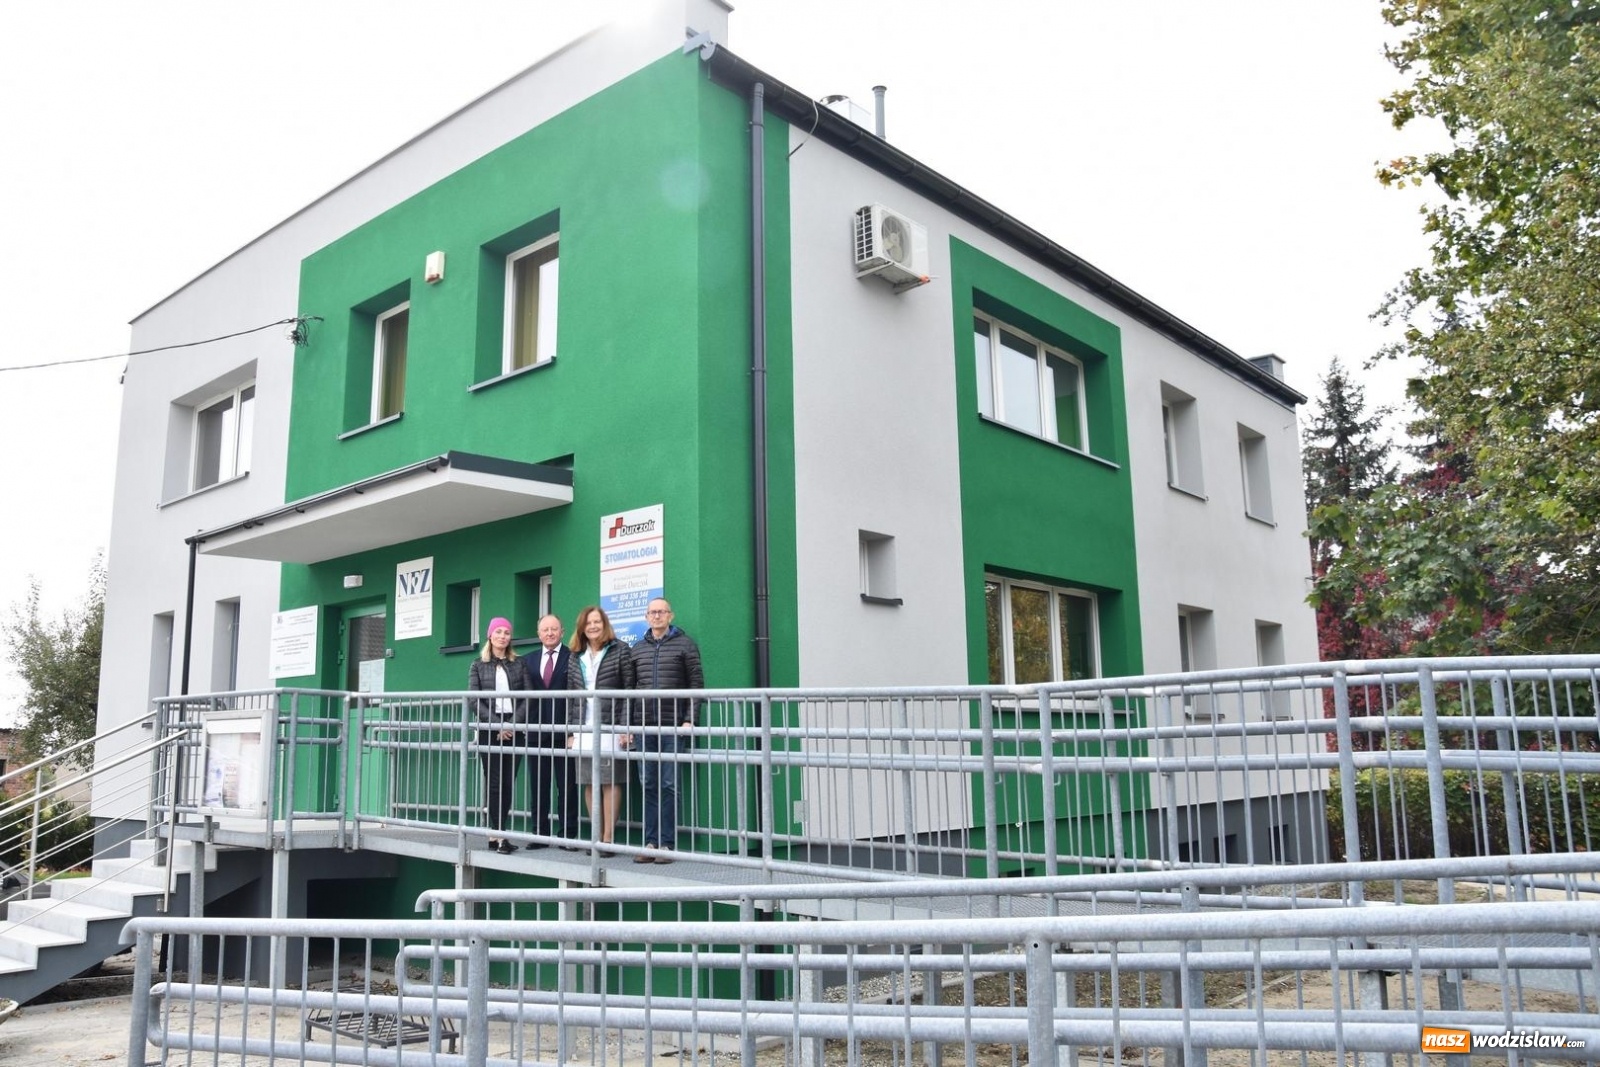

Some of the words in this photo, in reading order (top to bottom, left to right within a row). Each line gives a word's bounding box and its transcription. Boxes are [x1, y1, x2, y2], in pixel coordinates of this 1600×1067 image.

[620, 519, 655, 537] Durczok
[604, 545, 658, 564] STOMATOLOGIA
[398, 568, 430, 598] NFZ
